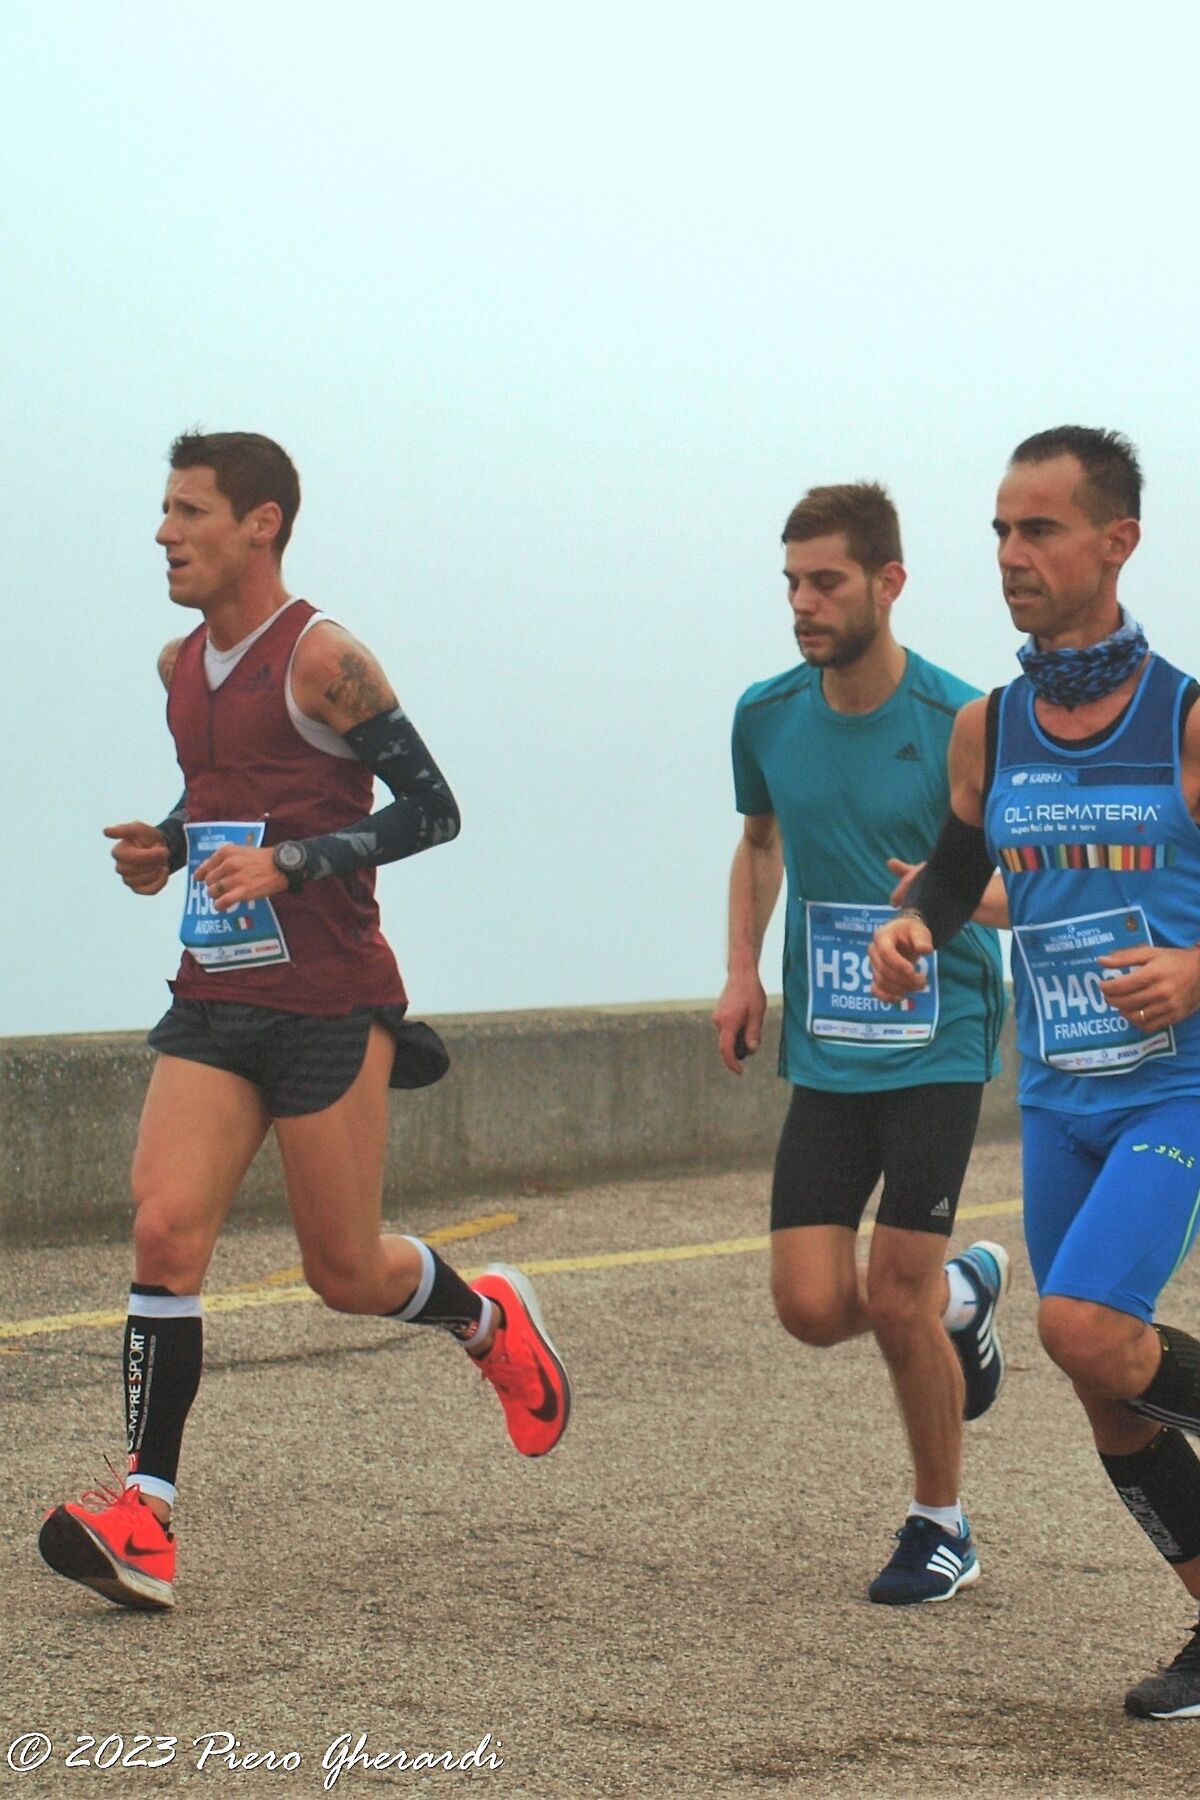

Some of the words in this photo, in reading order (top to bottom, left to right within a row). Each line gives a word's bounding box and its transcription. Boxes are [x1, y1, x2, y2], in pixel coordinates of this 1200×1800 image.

[1029, 773, 1062, 785] KARHU
[831, 994, 892, 1013] ROBERTO
[1054, 1016, 1129, 1040] FRANCESCO
